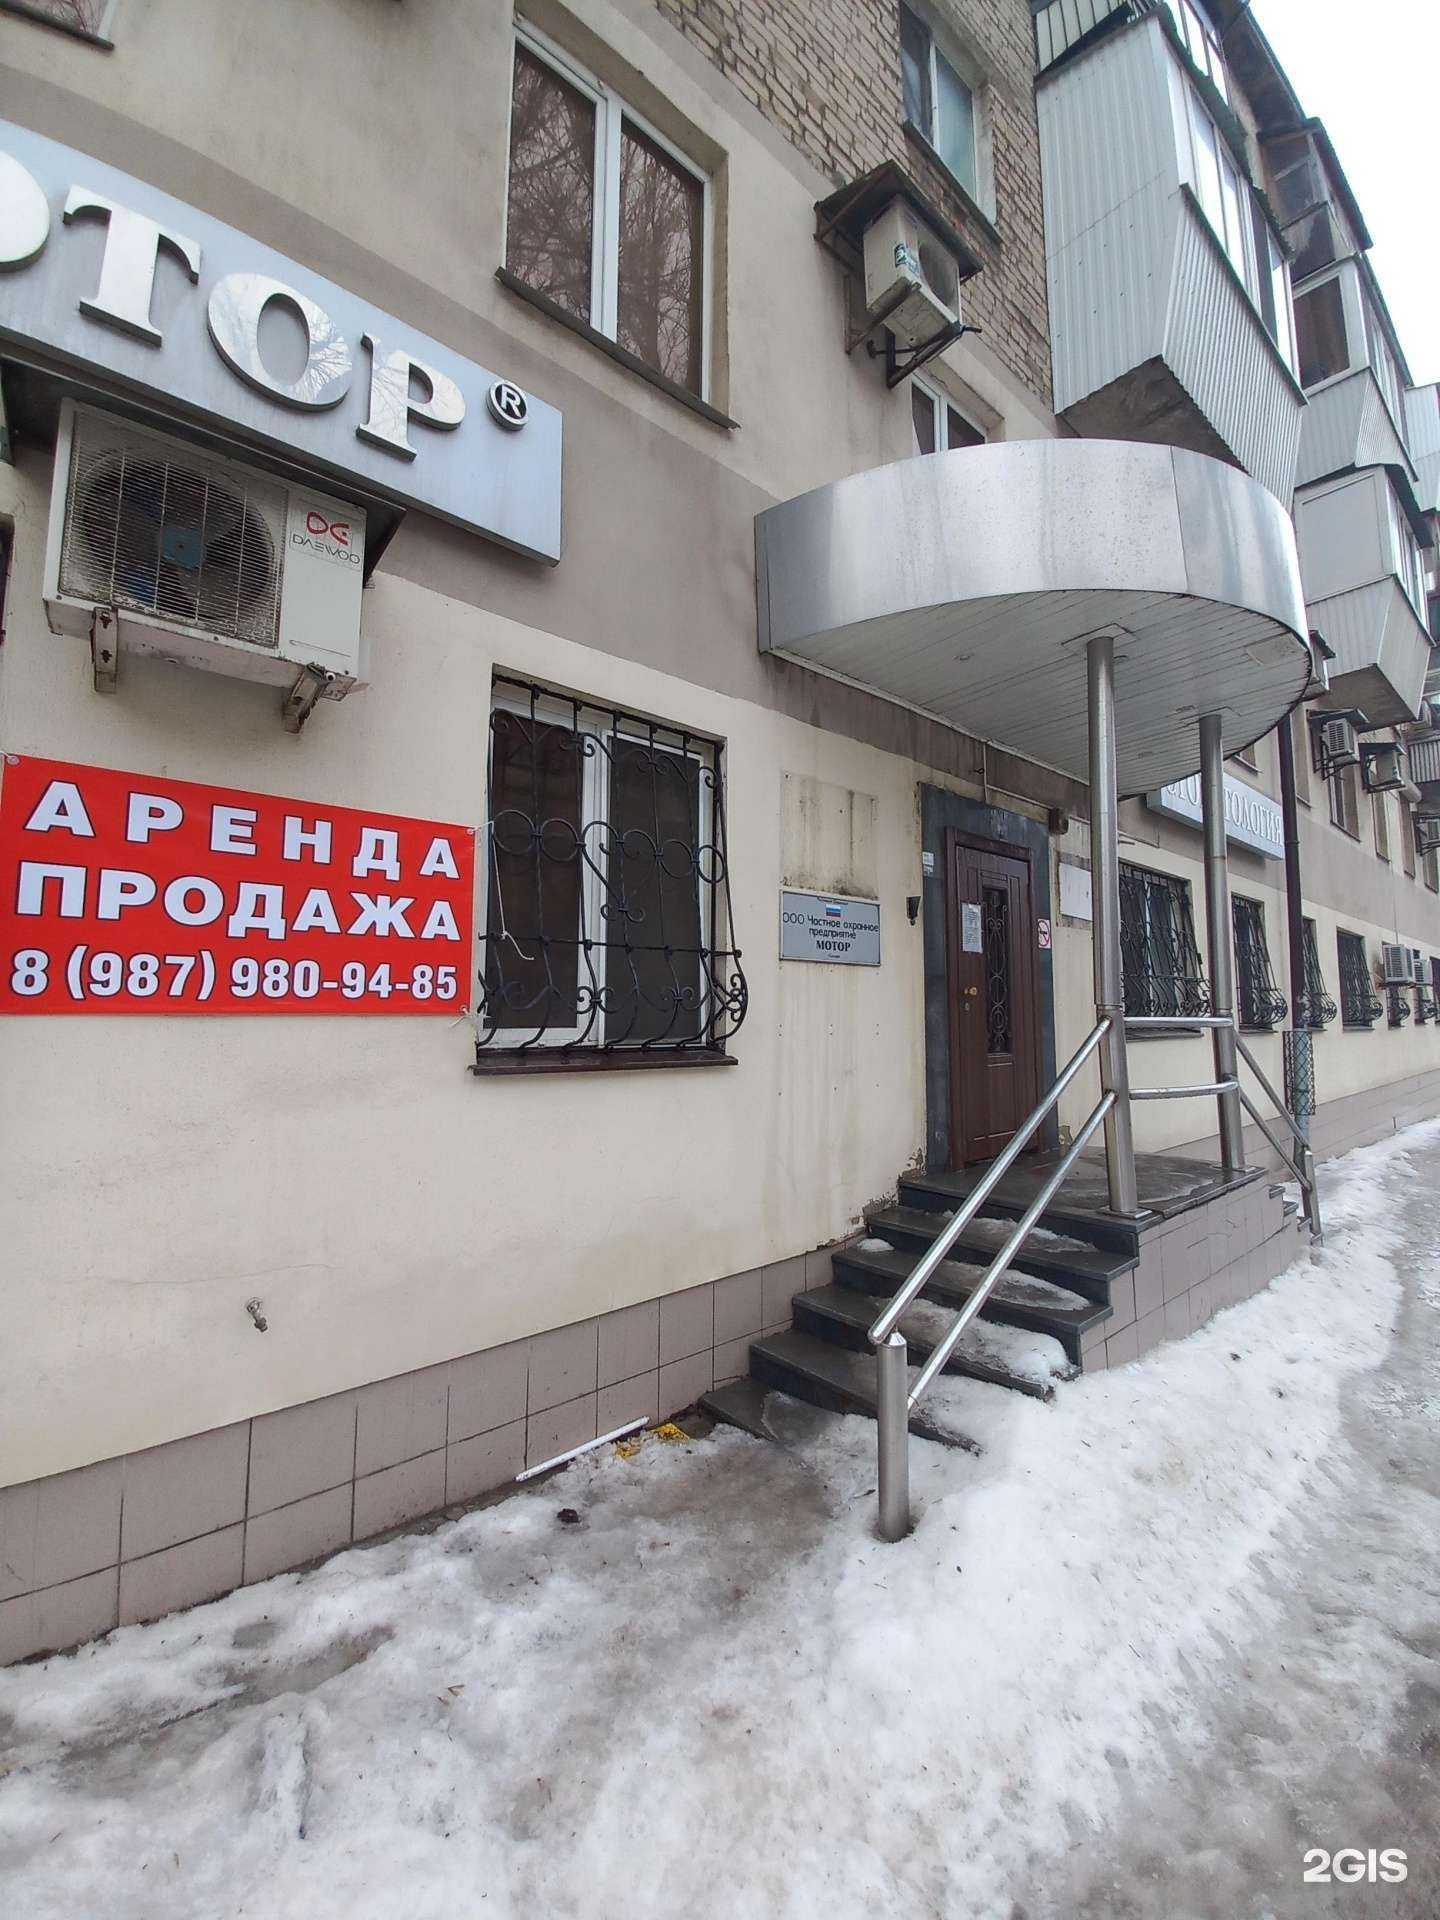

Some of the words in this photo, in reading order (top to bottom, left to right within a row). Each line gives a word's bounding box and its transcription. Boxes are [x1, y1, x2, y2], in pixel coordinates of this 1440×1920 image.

[292, 533, 361, 565] DAEWOO
[23, 780, 461, 881] АРЕНДА
[15, 861, 462, 941] ПРОДАЖА
[782, 911, 805, 925] ООО
[816, 940, 851, 952] МОТОР
[9, 948, 51, 997] 8
[65, 945, 216, 1000] (987)
[230, 956, 458, 1001] 980-94-85
